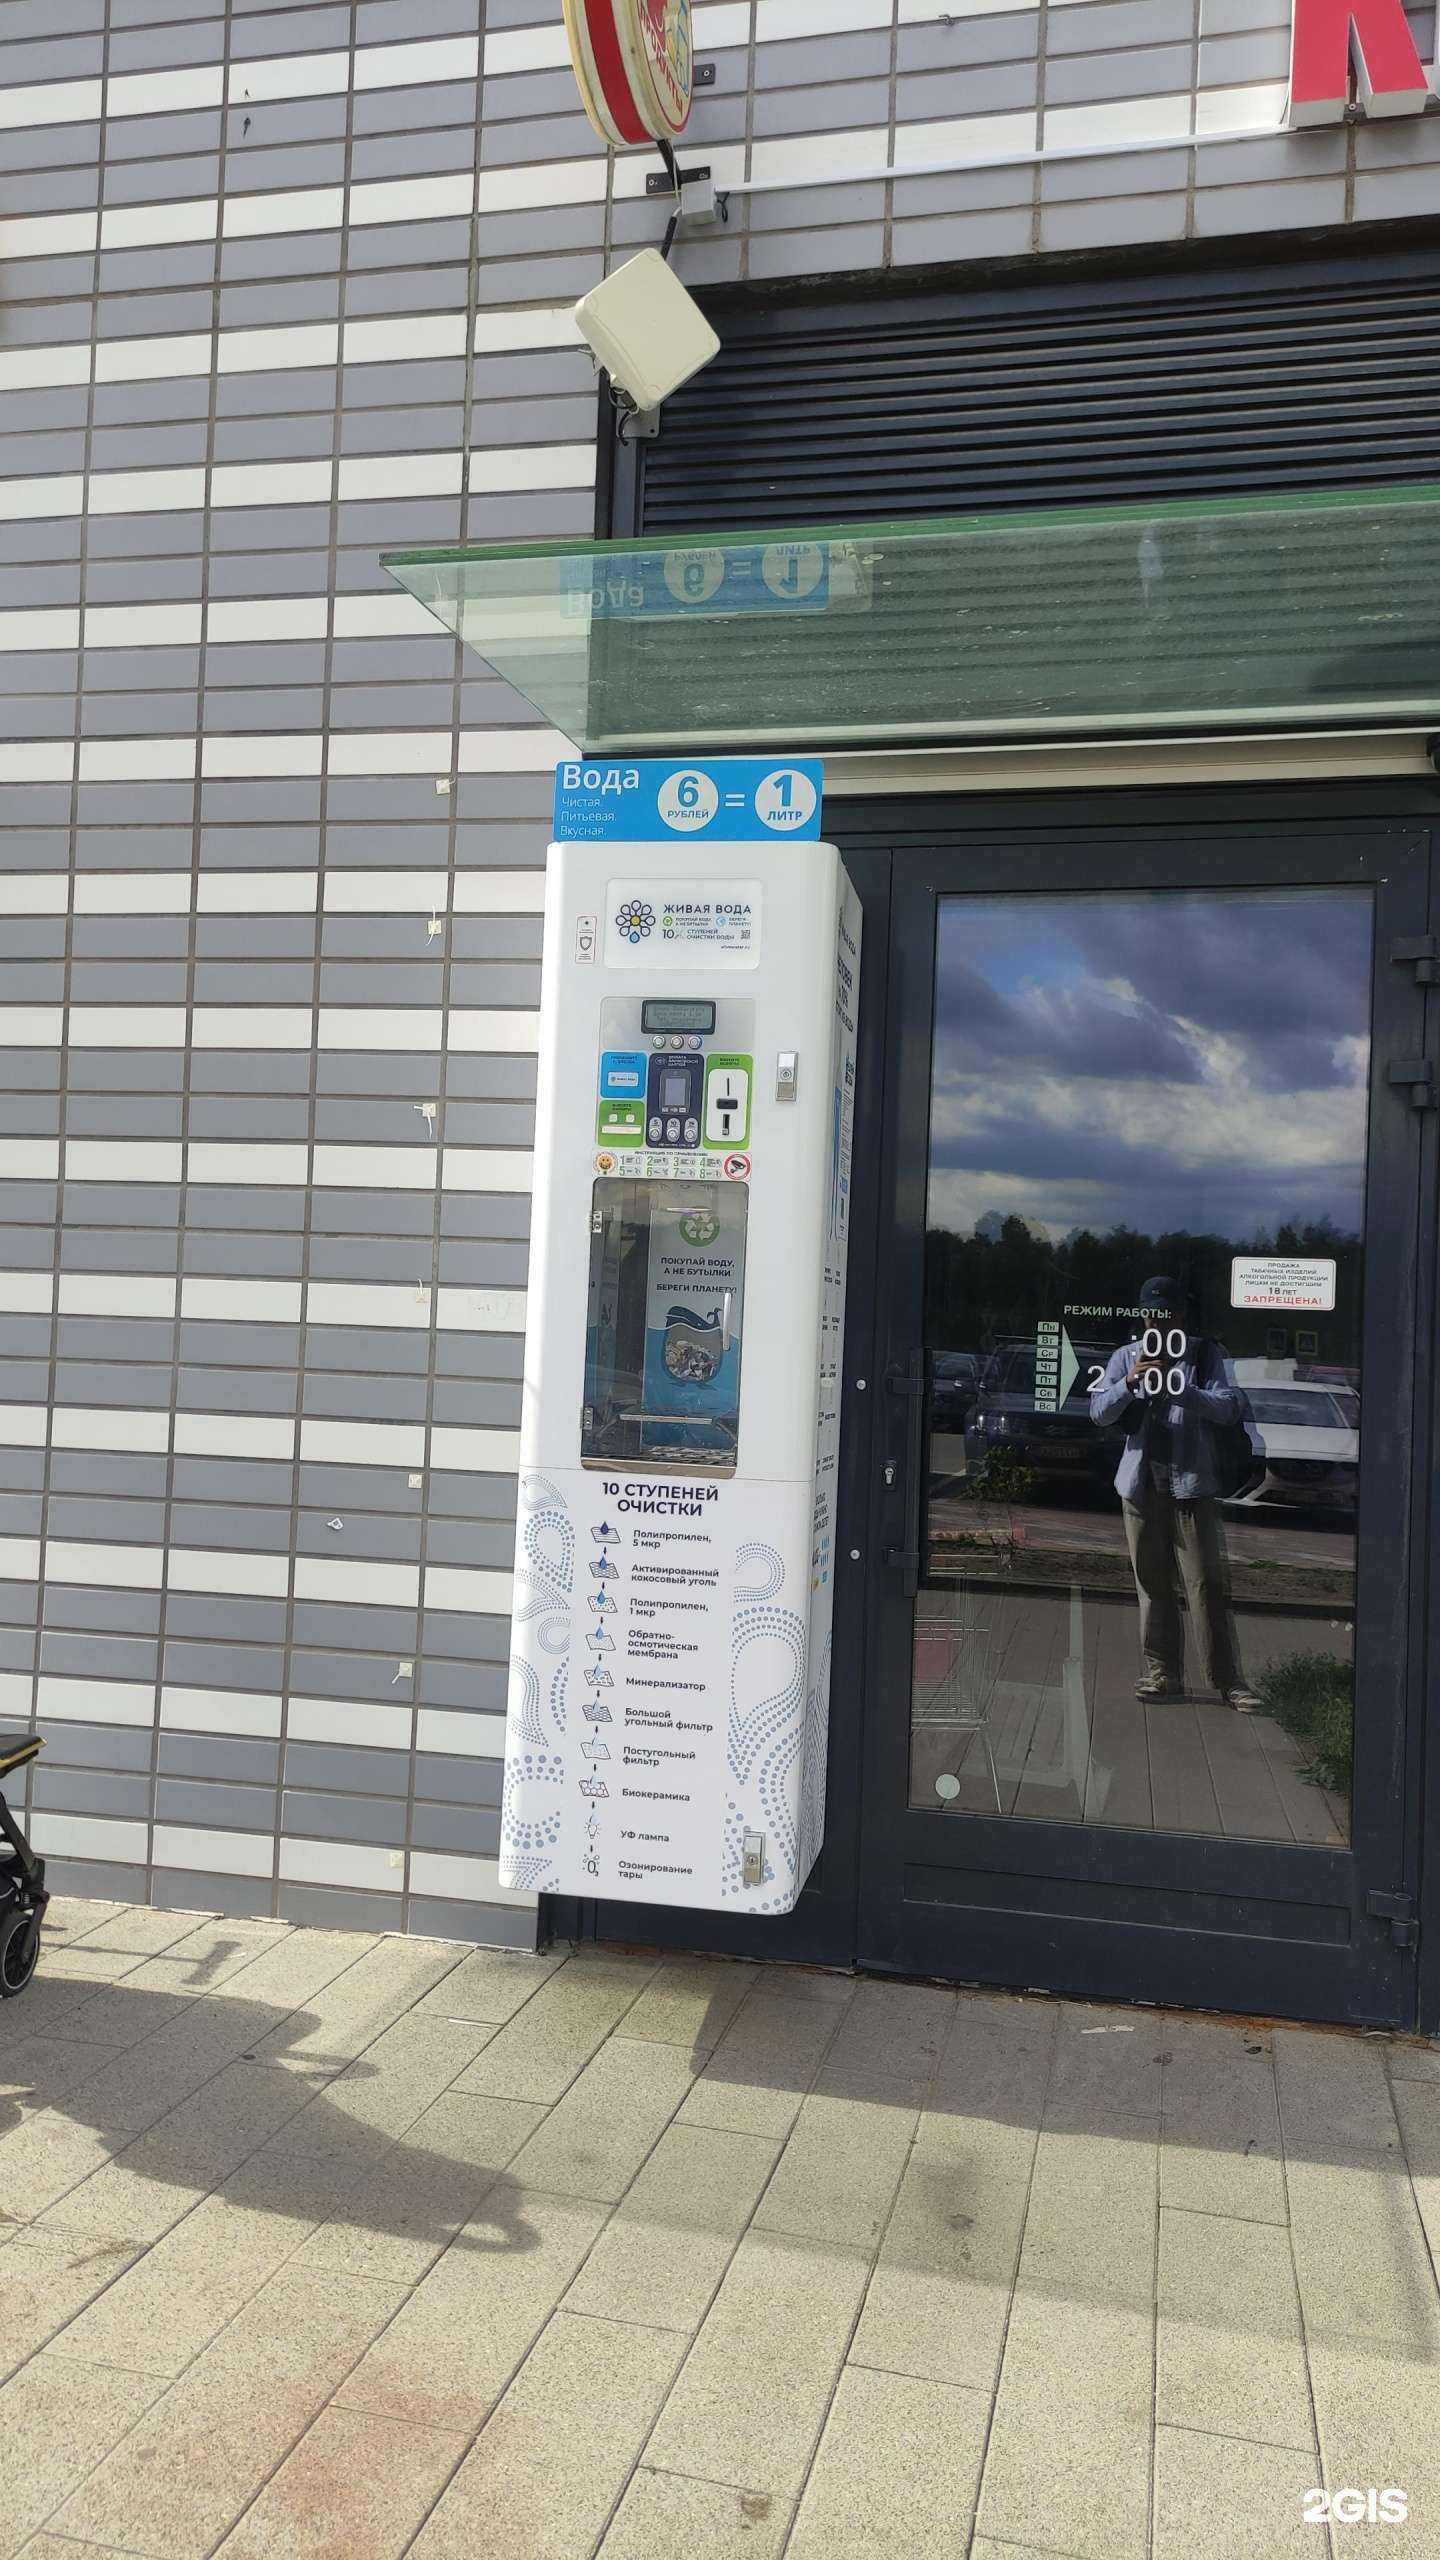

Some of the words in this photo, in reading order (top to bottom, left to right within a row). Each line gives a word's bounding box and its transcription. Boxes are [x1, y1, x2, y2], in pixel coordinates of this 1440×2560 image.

[562, 764, 640, 795] Вода
[677, 775, 700, 808] 6
[773, 774, 792, 807] 1
[667, 808, 709, 819] РУБЛЕЙ
[767, 810, 803, 822] ЛИТР
[663, 904, 711, 914] ЖИВАЯ
[715, 904, 752, 915] ВОДА
[663, 929, 675, 939] 10
[660, 1256, 706, 1267] ПОКУПАЙ
[707, 1259, 735, 1269] ВОДУ,
[663, 1267, 671, 1275] А
[672, 1268, 685, 1276] НЕ
[687, 1268, 731, 1278] БУТЫЛКИ
[656, 1283, 690, 1293] БЕРЕГИ
[1269, 1287, 1281, 1295] 18
[1243, 1295, 1322, 1305] ЗАПРЕЩЕНА!
[1063, 1304, 1113, 1318] РЕЖИМ
[1115, 1306, 1172, 1319] РАБОТЫ:
[1040, 1362, 1052, 1371] Чт
[1040, 1375, 1052, 1385] Пт
[602, 1482, 619, 1496] 10
[624, 1483, 719, 1501] СТУПЕНЕЙ
[617, 1499, 703, 1516] ОЧИСТКИ
[633, 1529, 712, 1544] Полипропилен,
[641, 1541, 661, 1549] мкр
[631, 1564, 719, 1577] Активированный
[631, 1575, 686, 1585] кокосовый
[688, 1578, 717, 1587] уголь
[630, 1598, 709, 1612] Полипропилен,
[635, 1609, 656, 1618] мкр
[628, 1629, 675, 1640] Обратно-
[627, 1640, 699, 1651] осмотическая
[627, 1649, 679, 1660] мембрана
[625, 1677, 706, 1692] Минерализатор
[625, 1707, 671, 1719] Большой
[624, 1718, 674, 1730] угольный
[675, 1721, 713, 1733] фильтр
[623, 1746, 696, 1760] Постугольный
[622, 1756, 660, 1767] фильтр
[622, 1788, 691, 1802] Биокерамика
[620, 1830, 636, 1840] УФ
[638, 1833, 670, 1843] лампа
[618, 1860, 693, 1875] Озонирование
[618, 1870, 643, 1880] тары
